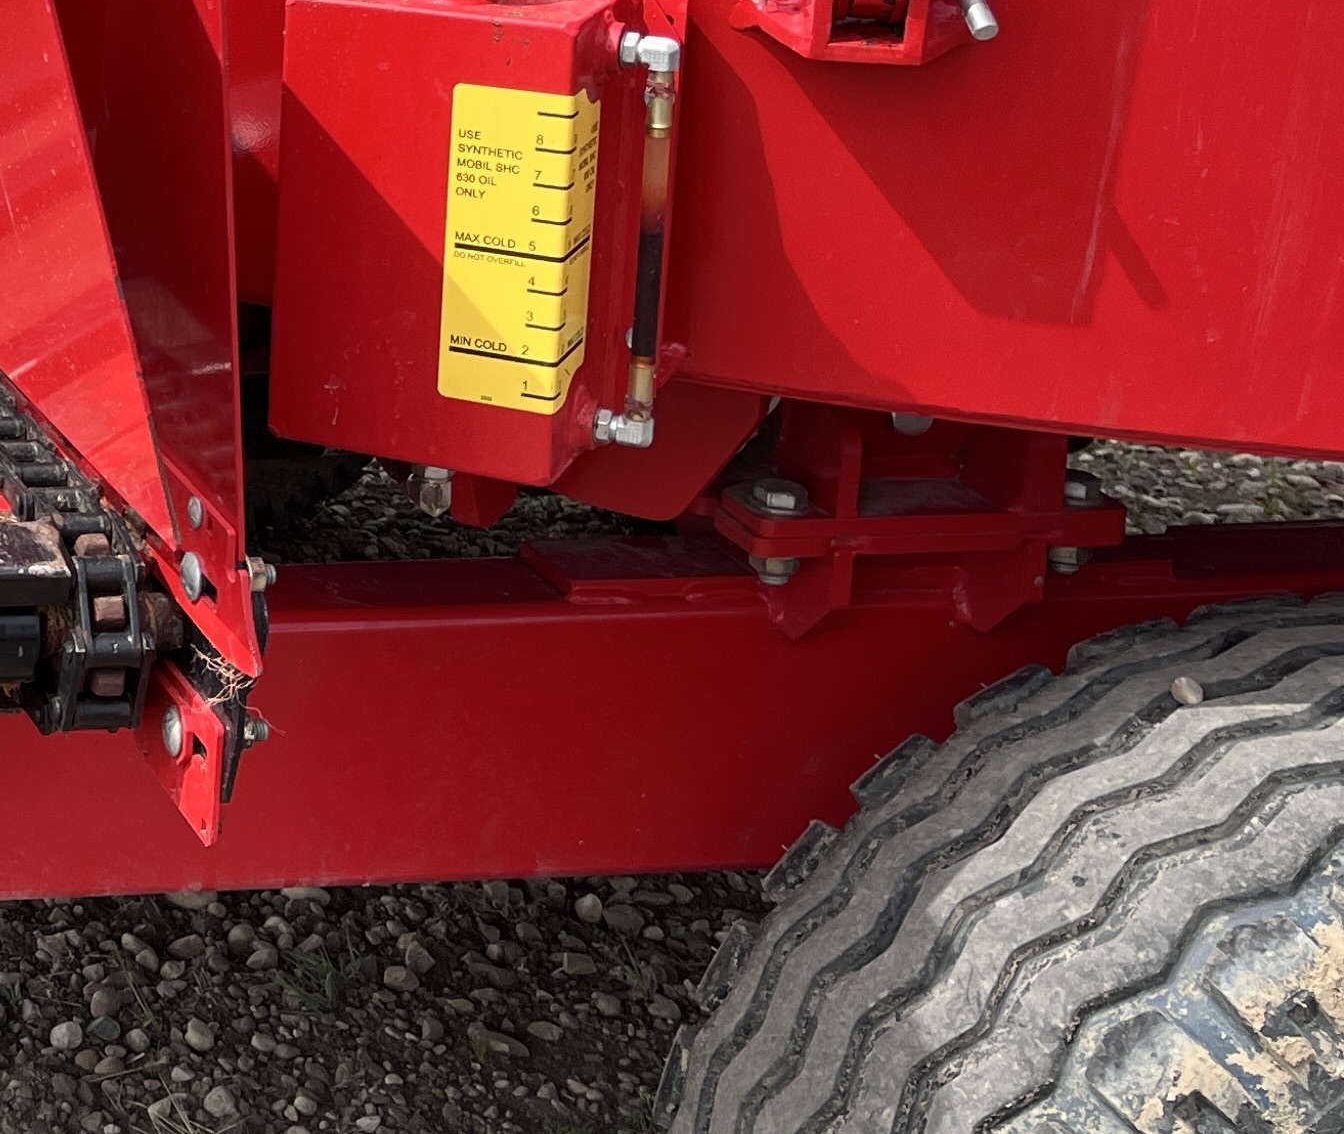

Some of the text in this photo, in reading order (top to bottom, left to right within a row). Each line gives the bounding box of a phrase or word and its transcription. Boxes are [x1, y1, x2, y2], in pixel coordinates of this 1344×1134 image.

[458, 129, 481, 140] USE
[536, 135, 544, 145] 8
[458, 144, 523, 160] SYNTHETIC
[456, 158, 519, 174] MOBIL SHC
[456, 172, 496, 185] 630 OIL
[534, 170, 542, 181] 7
[456, 186, 486, 199] ONLY
[532, 205, 540, 216] 6
[454, 231, 516, 248] MAX COLD
[528, 240, 536, 251] 5
[486, 255, 526, 267] OVERFILL
[527, 276, 535, 286] 4
[526, 310, 534, 321] 3
[449, 334, 507, 351] MIN COLD
[521, 345, 529, 355] 2
[523, 380, 528, 390] 1
